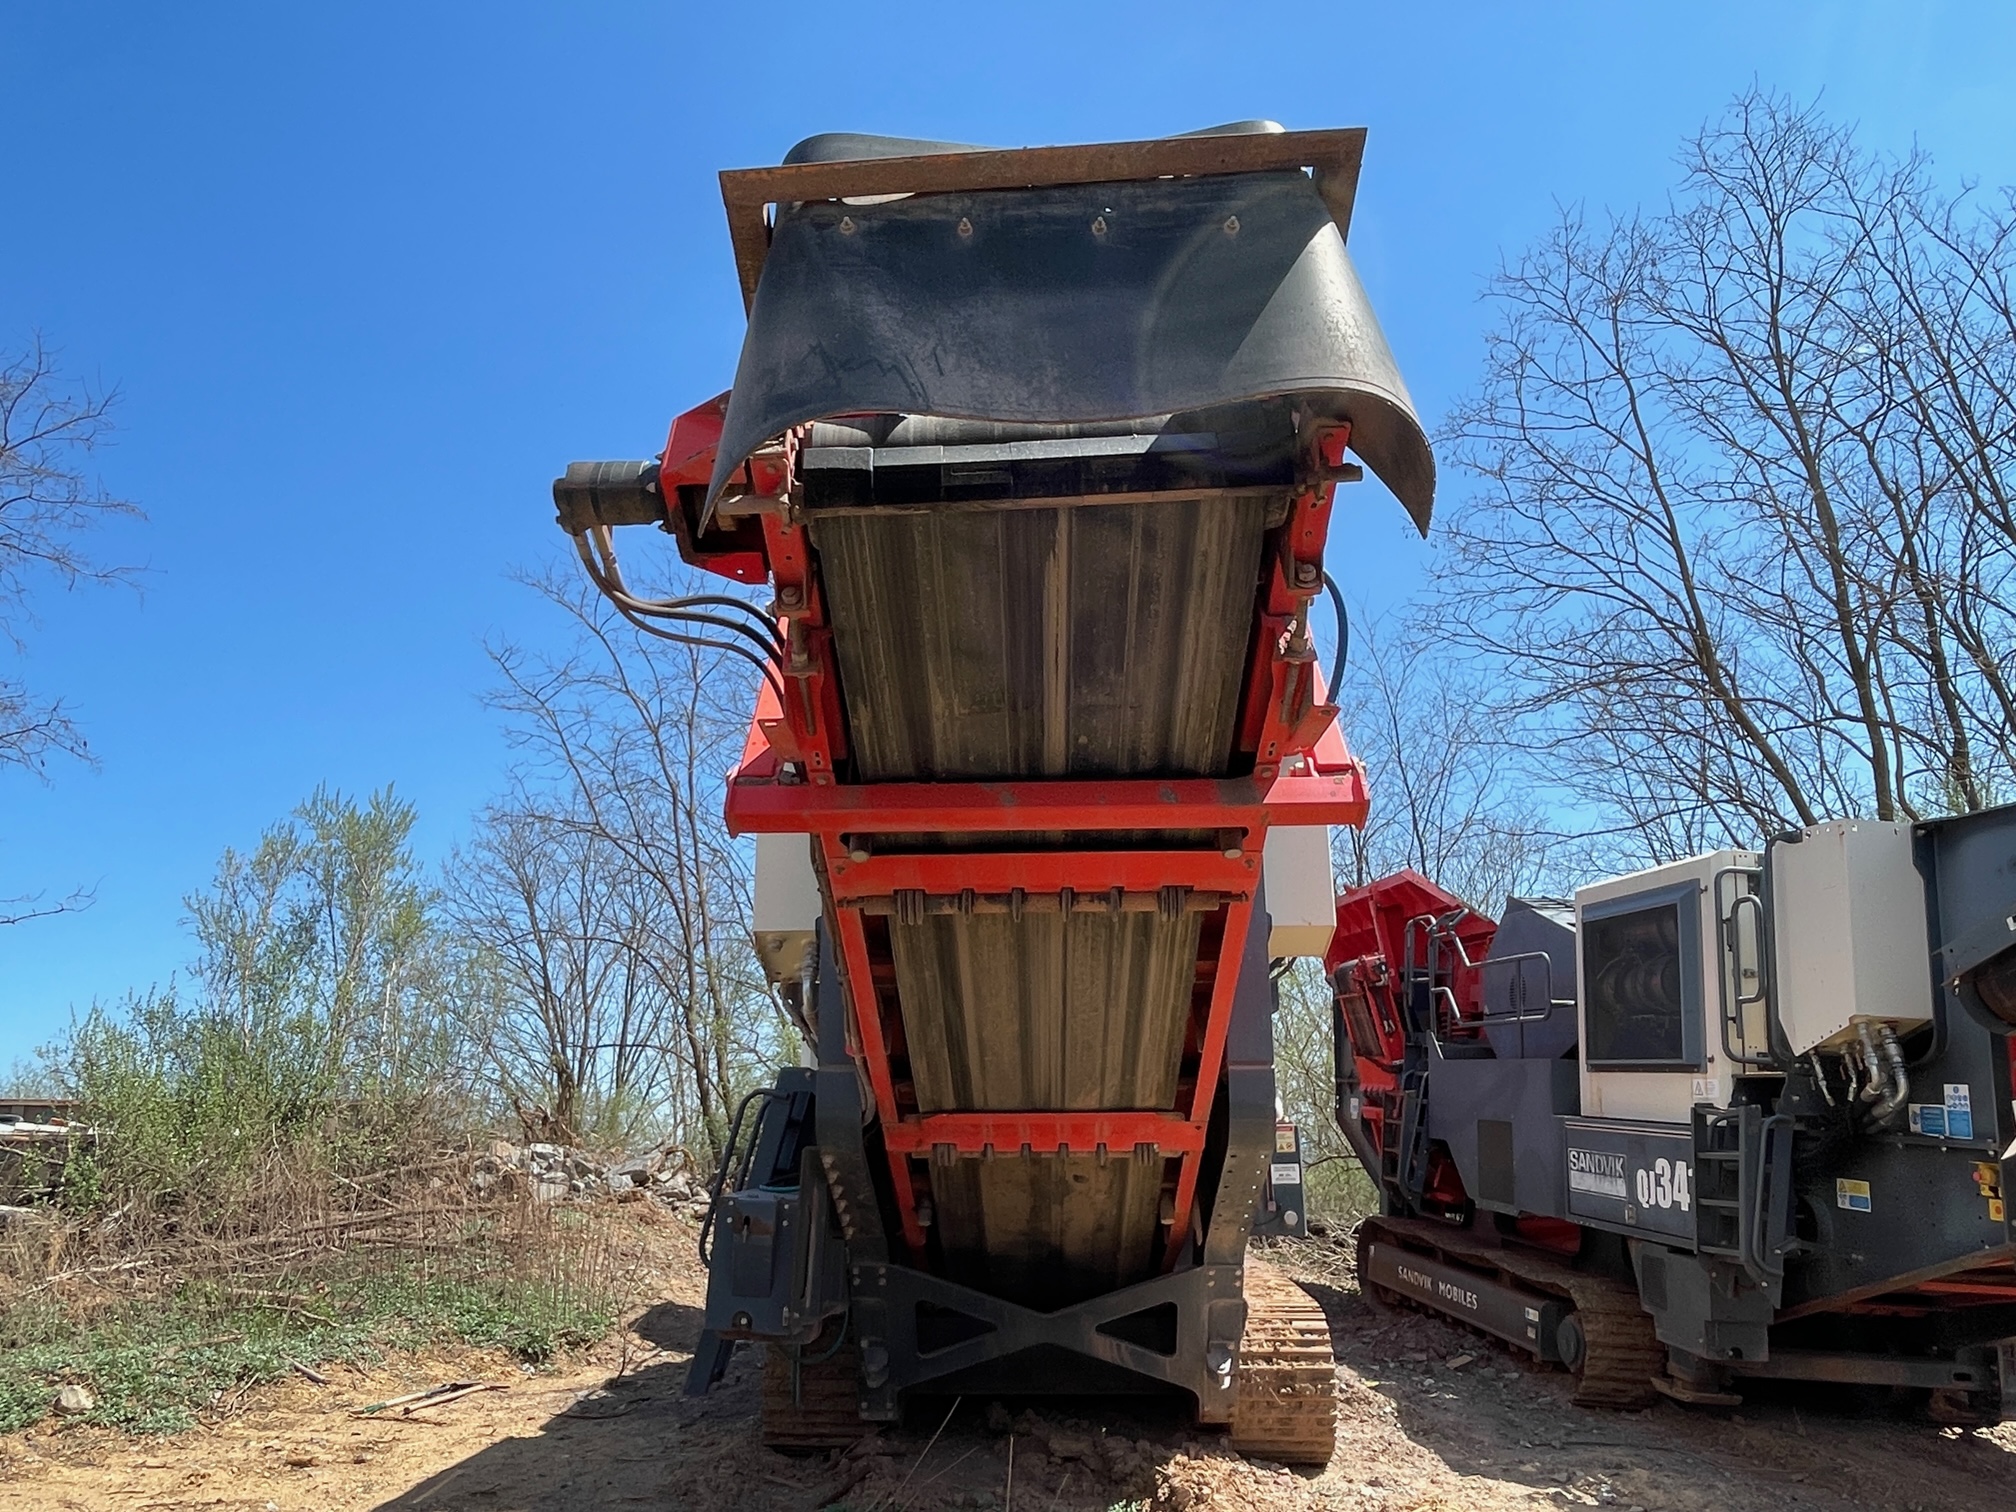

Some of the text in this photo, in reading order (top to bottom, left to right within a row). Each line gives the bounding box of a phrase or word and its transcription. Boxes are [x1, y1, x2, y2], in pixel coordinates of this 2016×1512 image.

[1570, 1150, 1624, 1177] SANDVIK
[1636, 1158, 1693, 1211] QJ34
[1397, 1265, 1479, 1310] SANDVIK MOBILES
